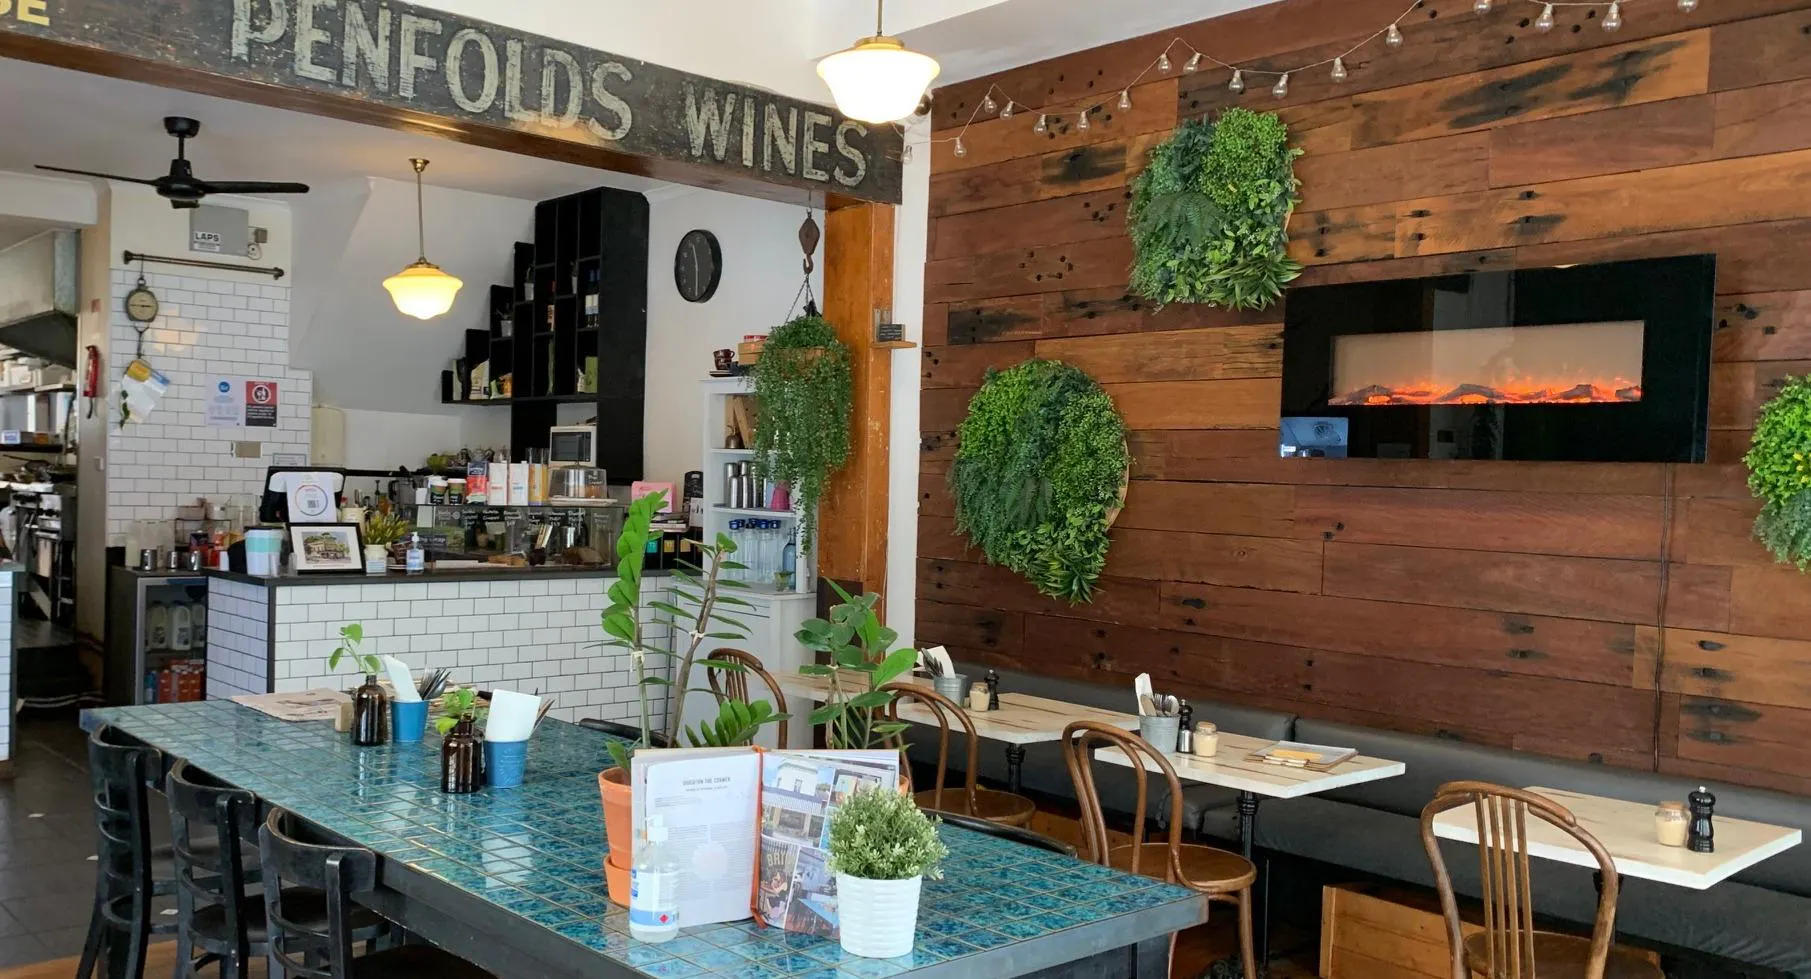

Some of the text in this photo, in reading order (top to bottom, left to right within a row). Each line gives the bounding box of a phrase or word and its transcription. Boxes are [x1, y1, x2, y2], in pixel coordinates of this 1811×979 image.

[230, 0, 868, 186] PENFOLDS WINES
[195, 232, 219, 242] LAPS
